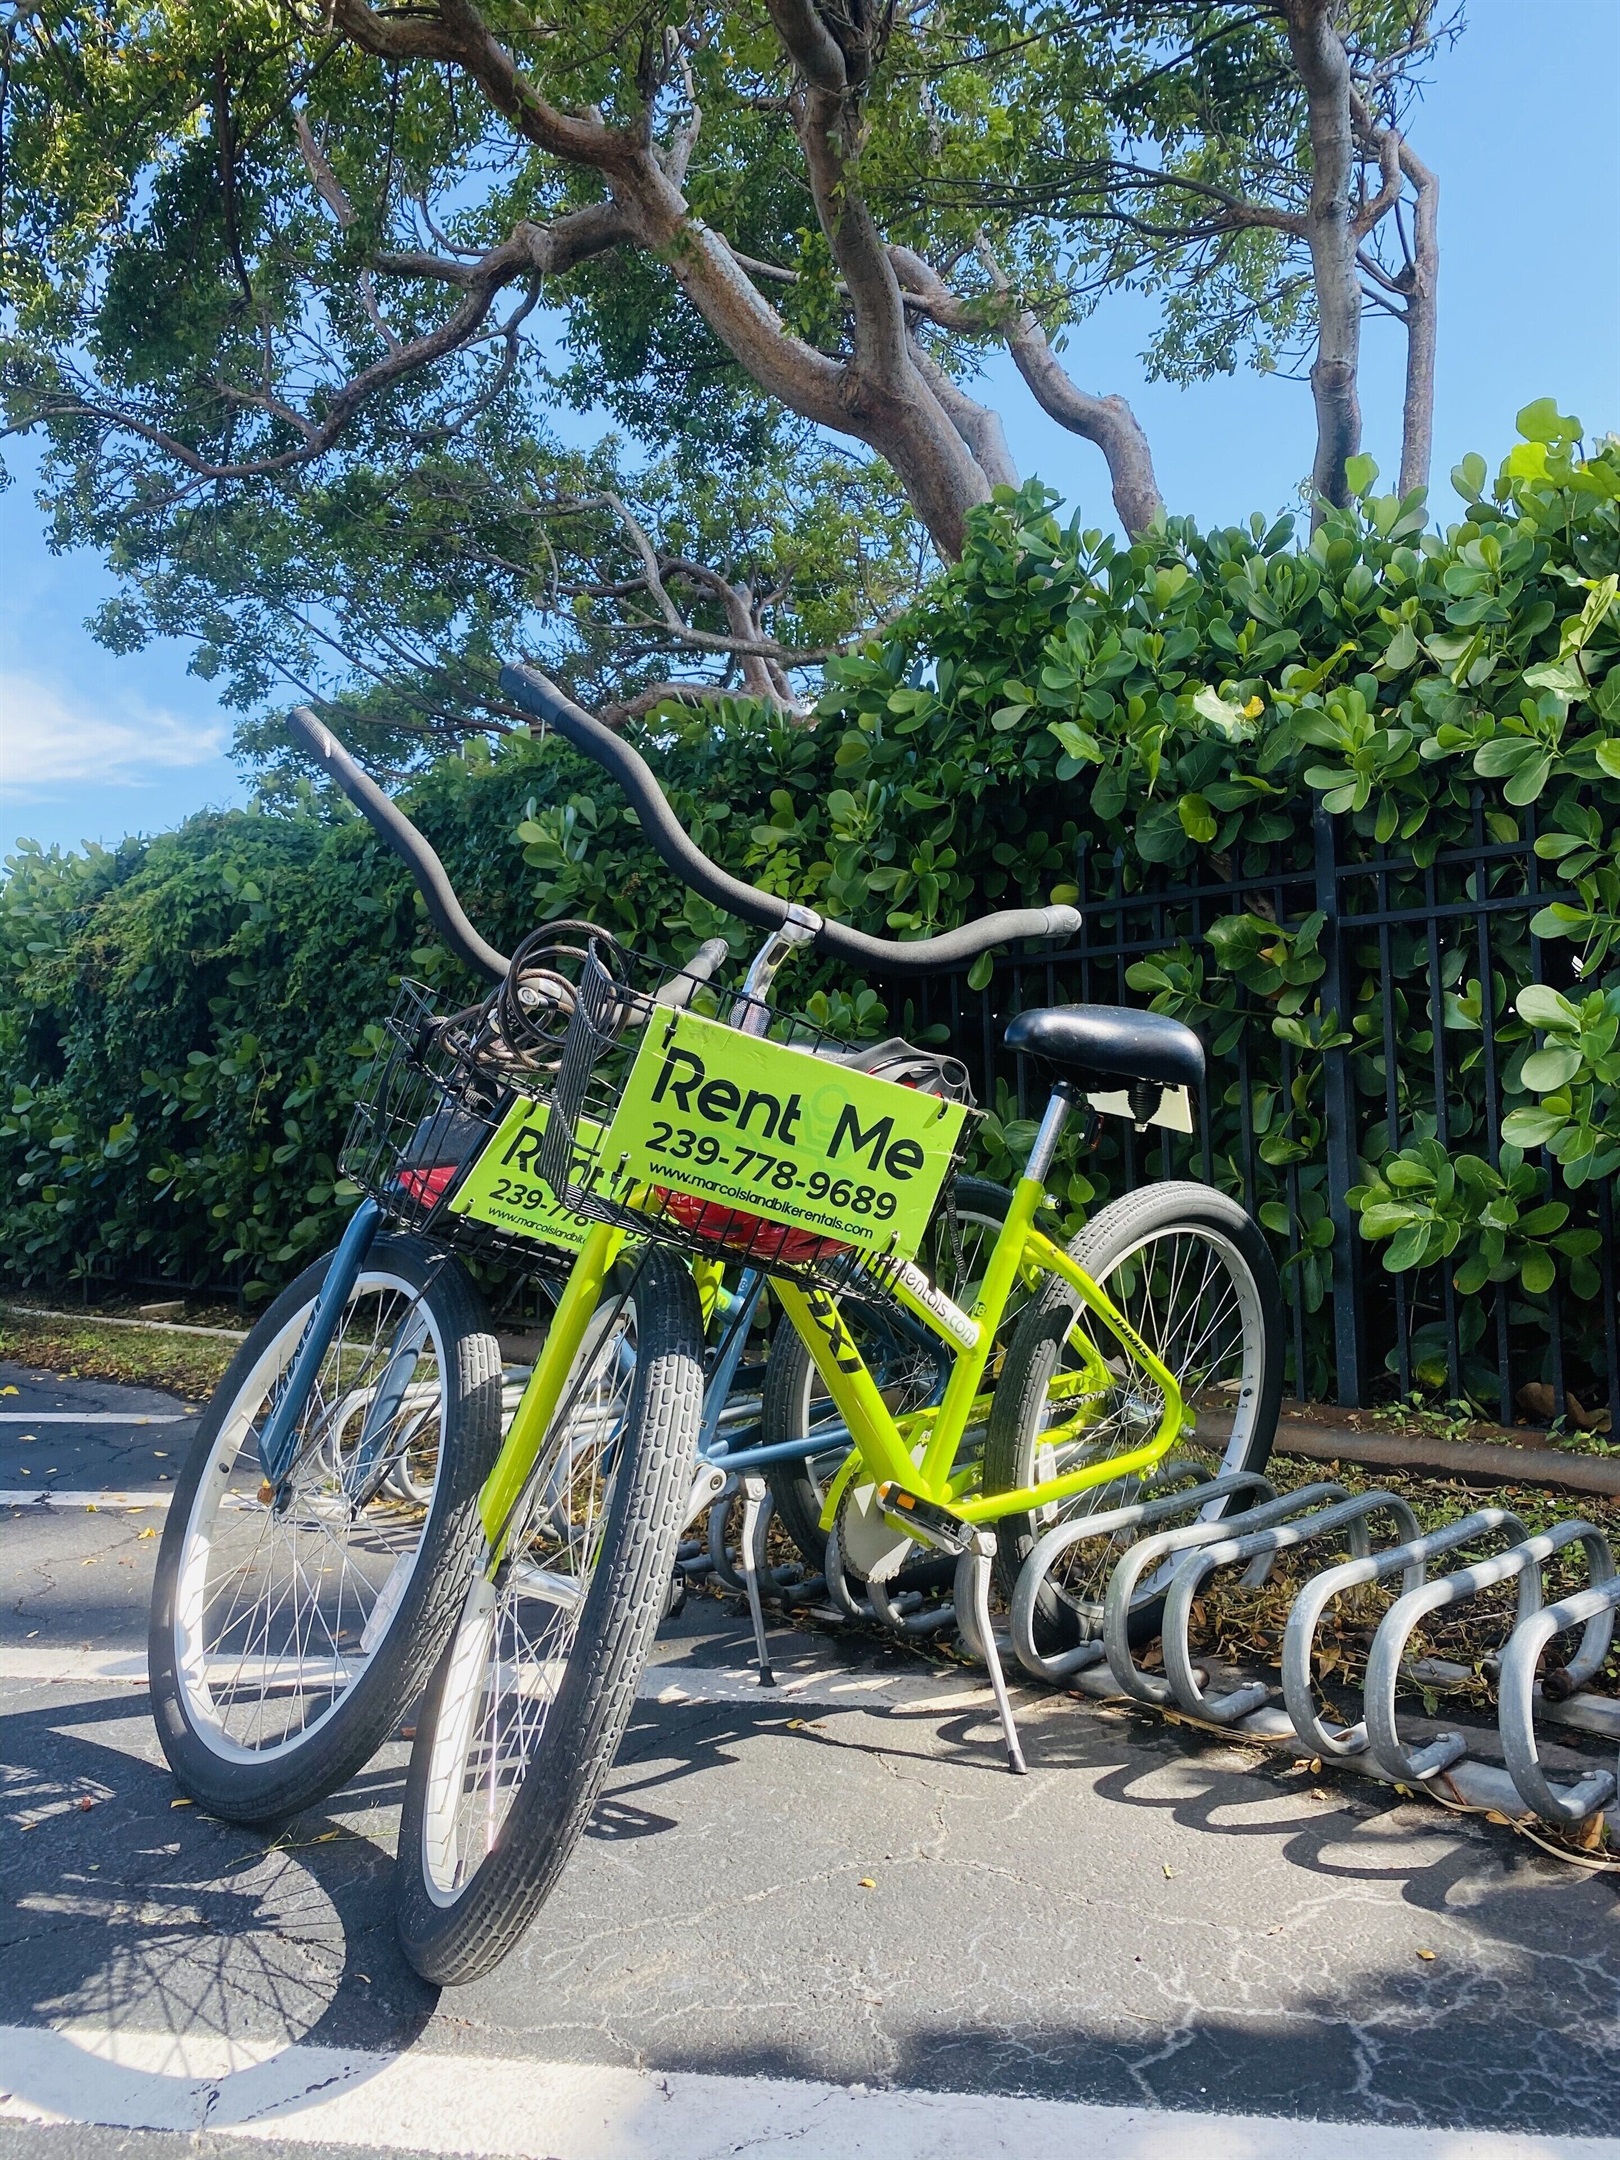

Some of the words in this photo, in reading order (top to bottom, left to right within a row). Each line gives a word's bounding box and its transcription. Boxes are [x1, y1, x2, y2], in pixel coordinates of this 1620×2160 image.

[651, 1046, 802, 1146] Rent
[826, 1103, 925, 1180] Me
[645, 1121, 897, 1220] 239-778-9689
[488, 1205, 587, 1244] www.marcoislandbik
[796, 1282, 864, 1375] AXI
[894, 1261, 976, 1346] Rentals.com
[973, 1303, 987, 1317] 18
[1108, 1313, 1150, 1359] JAMIS
